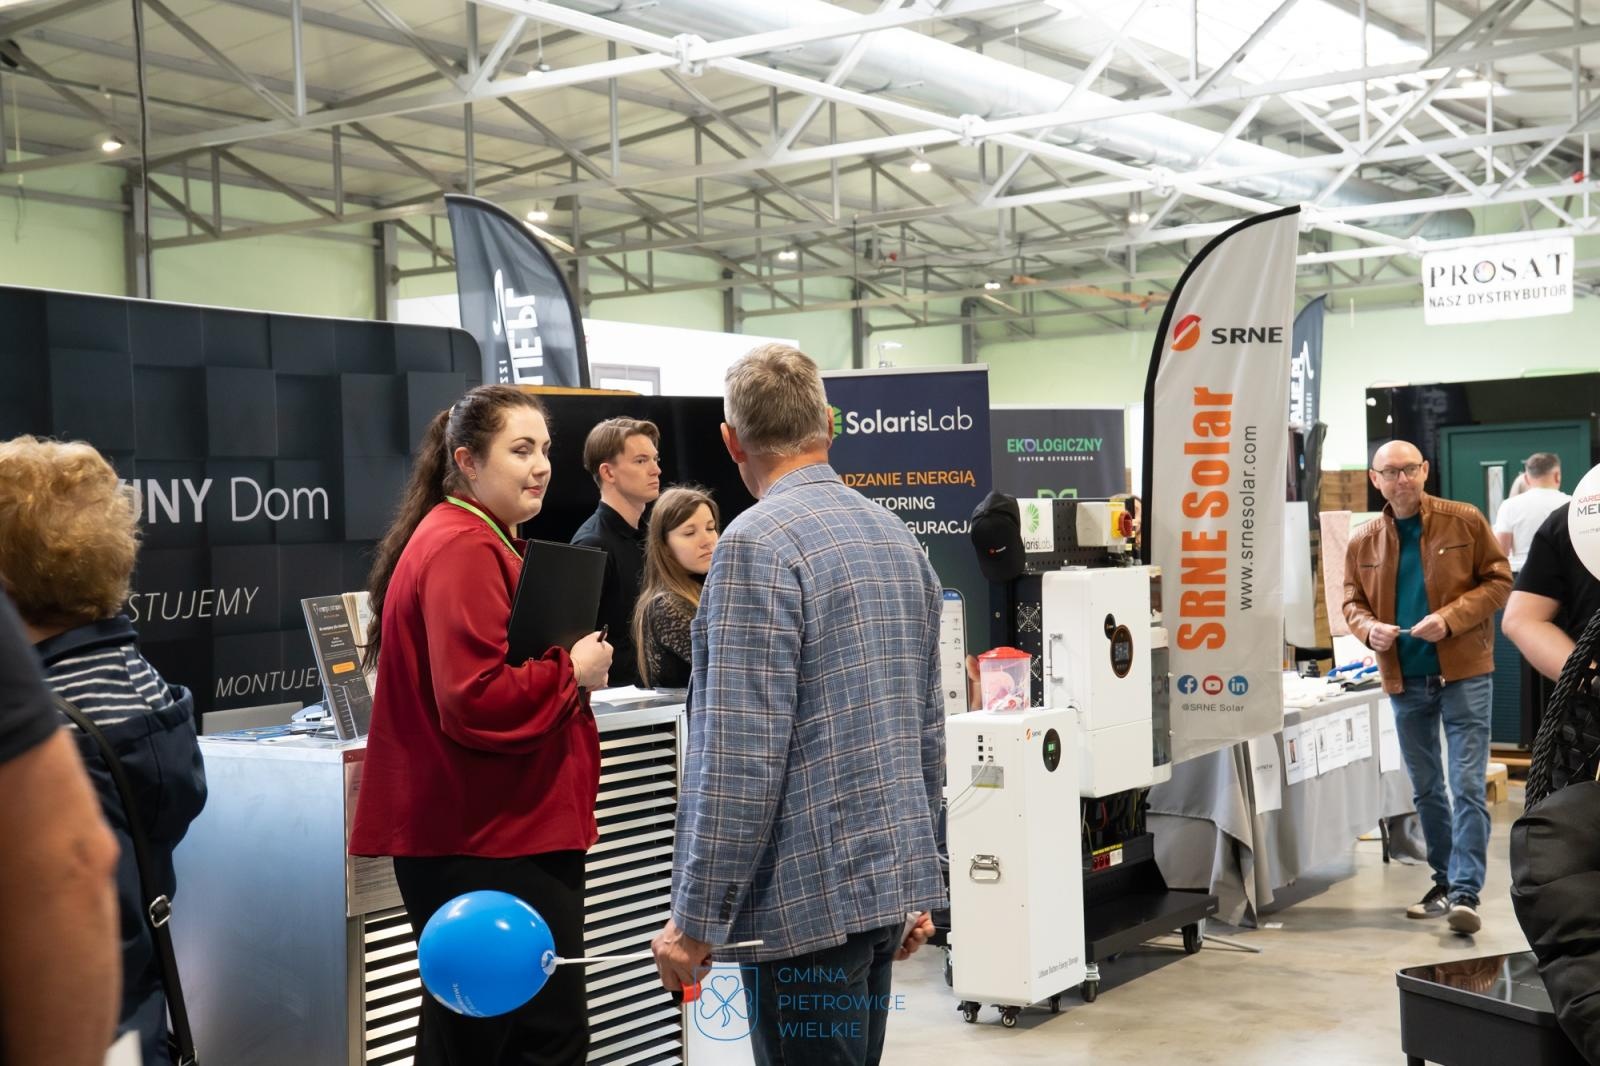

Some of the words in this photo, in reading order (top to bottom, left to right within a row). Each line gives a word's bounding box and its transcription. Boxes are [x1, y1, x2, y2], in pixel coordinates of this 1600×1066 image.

[1430, 252, 1568, 288] PROSAT
[1429, 294, 1462, 308] NASZ
[1468, 284, 1567, 305] DYSTRYBUTOR
[1211, 327, 1283, 344] SRNE
[846, 405, 973, 434] SolarisLab
[1007, 438, 1103, 453] EKOLOGICZNY
[1182, 386, 1232, 519] Solar
[907, 470, 976, 488] ENERGIĄ
[230, 476, 329, 522] Dom
[870, 496, 936, 510] TORING
[905, 520, 972, 534] GURACJ
[1240, 425, 1257, 610] www.srnesolar.com
[128, 586, 259, 623] STUJEMY
[1177, 530, 1226, 650] SRNE
[215, 667, 322, 698] MONTUJE
